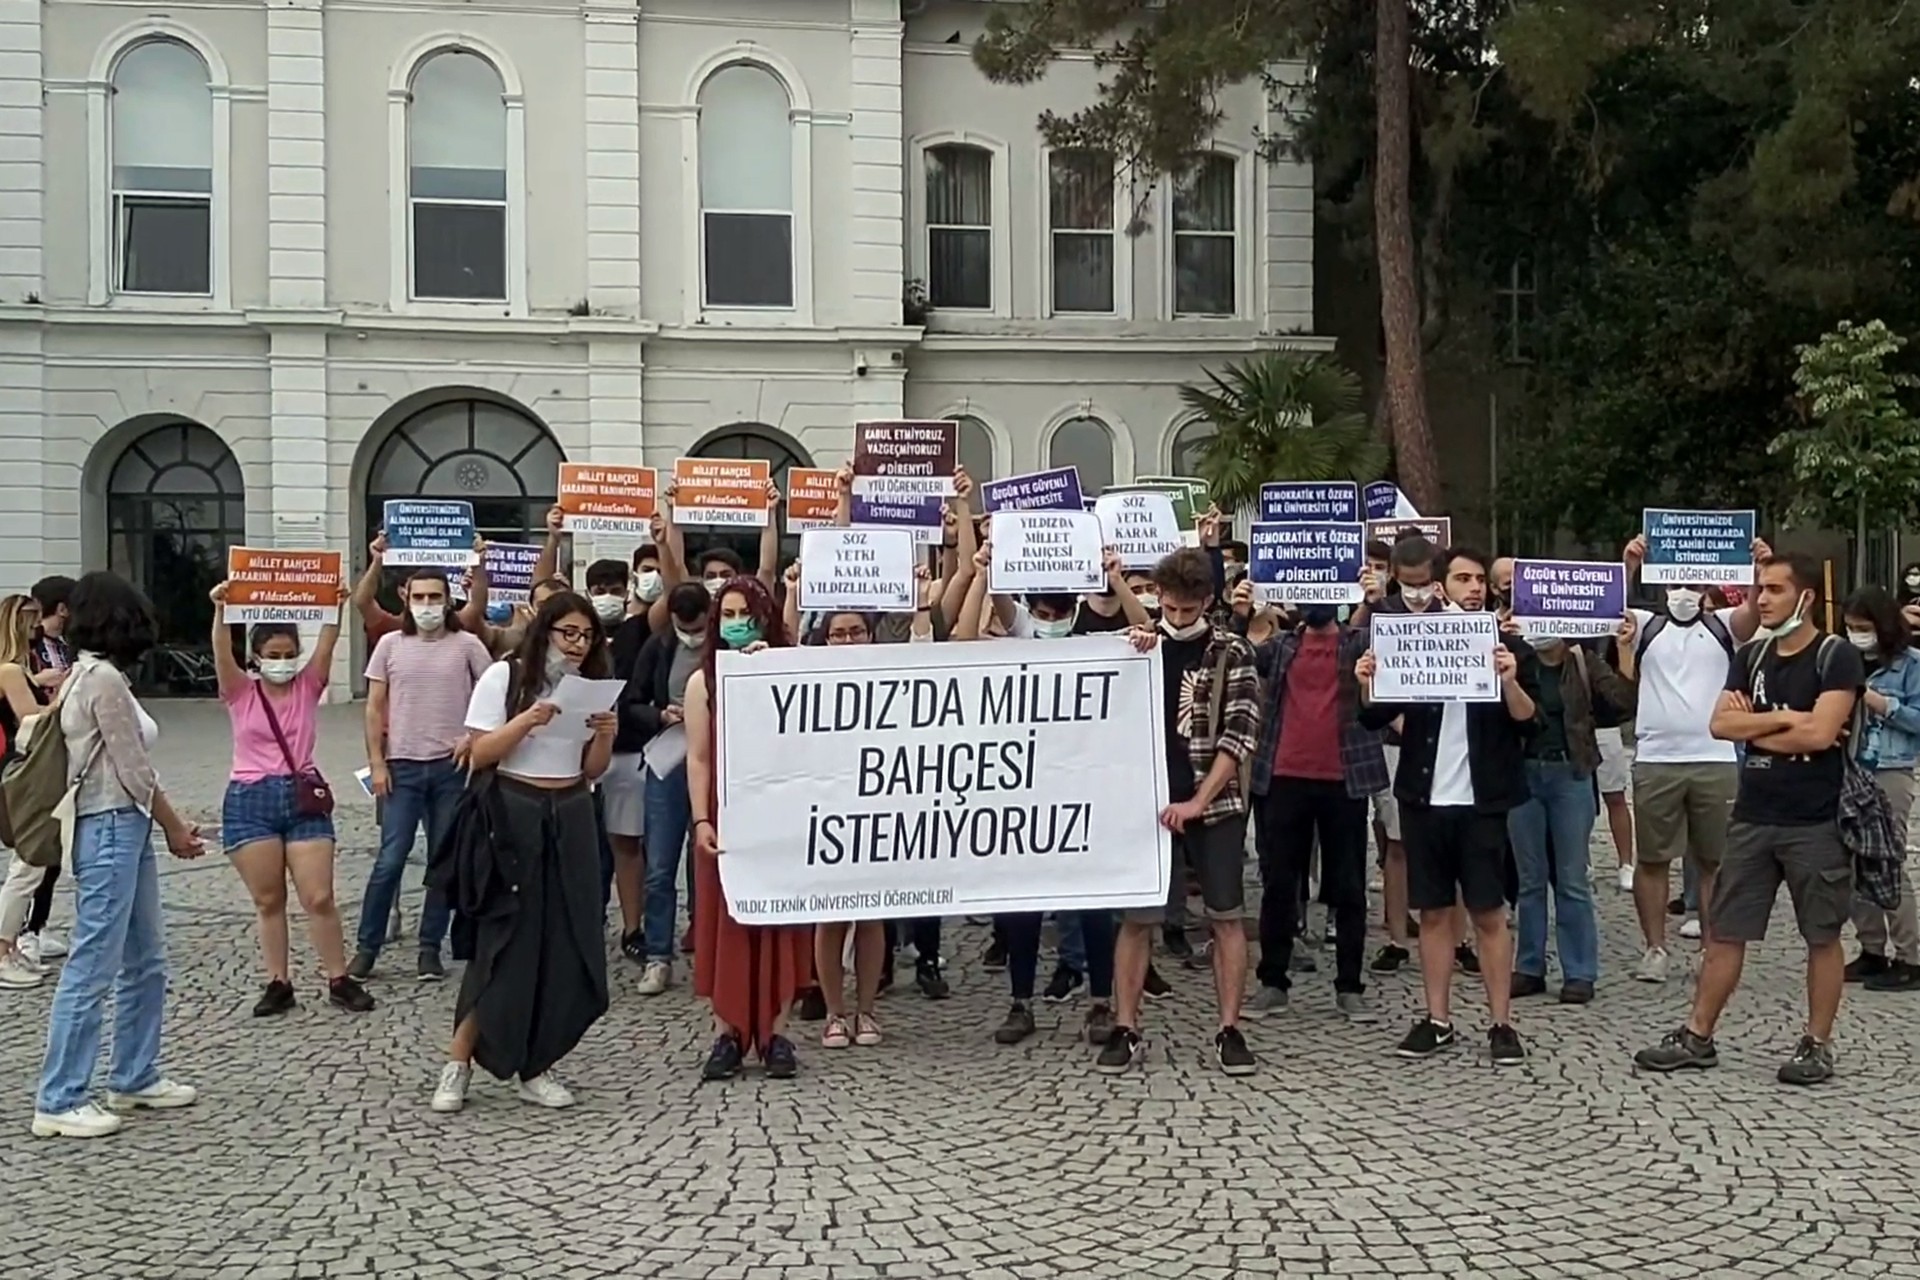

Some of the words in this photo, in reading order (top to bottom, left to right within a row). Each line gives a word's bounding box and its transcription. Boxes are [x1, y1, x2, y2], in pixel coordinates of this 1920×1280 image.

[865, 429, 892, 440] KABUL
[894, 427, 946, 441] ETMİYORUZ,
[867, 442, 941, 457] VAZGEÇMİYORUZ!
[692, 465, 719, 476] MİLLET
[720, 466, 751, 478] BAHÇESİ
[877, 461, 934, 475] #DİRENYTÜ
[577, 470, 605, 482] MİLLET
[607, 472, 639, 485] BAHÇESİ
[868, 480, 885, 492] YTÜ
[887, 479, 943, 493] ÖĞRENCİLERİ
[992, 484, 1019, 501] ÖZGÜR
[1019, 484, 1032, 495] VE
[1032, 474, 1068, 493] GÜVENLİ
[1015, 492, 1064, 510] ÜNİVERSİTE
[1263, 488, 1314, 501] DEMOKRATİK
[1316, 489, 1326, 499] VE
[1328, 488, 1354, 499] ÖZERK
[870, 506, 916, 519] İSTİYORUZ!
[1268, 501, 1283, 513] BİR
[1284, 501, 1330, 514] ÜNİVERSİTE
[1331, 501, 1349, 516] İÇİN
[688, 511, 703, 521] YTÜ
[705, 510, 756, 522] ÖĞRENCİLERİ
[1662, 513, 1733, 526] ÜNİVERSİTEMİZDE
[398, 526, 412, 536] SÖZ
[573, 519, 589, 530] YTÜ
[591, 518, 644, 532] ÖĞRENCİLERİ
[1025, 531, 1071, 544] MİLLET
[1115, 527, 1158, 539] KARAR
[1252, 529, 1313, 544] DEMOKRATİK
[1315, 531, 1327, 544] VE
[1329, 529, 1360, 544] ÖZERK
[1651, 528, 1690, 537] ALINACAK
[1692, 528, 1745, 538] KARARLARDA
[1661, 538, 1676, 549] SÖZ
[1678, 538, 1705, 549] SAHİBİ
[1707, 540, 1735, 549] OLMAK
[398, 551, 413, 562] YTÜ
[415, 550, 467, 562] ÖĞRENCİLERİ
[1022, 545, 1073, 559] BAHÇESİ
[1257, 545, 1274, 560] BİR
[1276, 545, 1332, 559] ÜNİVERSİTE
[1334, 545, 1355, 562] İÇİN
[1675, 551, 1719, 562] İSTİYORUZ!
[249, 556, 280, 568] MİLLET
[283, 558, 321, 571] BAHÇESİ
[230, 571, 272, 582] KARARINI
[275, 572, 337, 583] TANIMIYORUZ!
[834, 565, 880, 578] KARAR
[1275, 566, 1339, 581] #DİRENYTÜ
[1523, 567, 1556, 580] ÖZGÜR
[1558, 570, 1570, 581] VE
[1572, 569, 1613, 582] GÜVENLİ
[1659, 569, 1676, 580] YTÜ
[1679, 567, 1738, 581] ÖĞRENCİLERİ
[809, 581, 905, 594] YILDIZLILARIN!
[1265, 588, 1283, 600] YTÜ
[1286, 587, 1349, 601] ÖĞRENCİLERİ
[1532, 582, 1548, 595] BİR
[1551, 582, 1605, 596] ÜNİVERSİTE
[1542, 597, 1594, 611] İSTİYORUZ!
[241, 608, 260, 620] YTÜ
[263, 607, 323, 620] ÖĞRENCİLERİ
[1376, 619, 1492, 636] KAMPÜSLERİMİZ
[1528, 621, 1546, 633] YTÜ
[1549, 620, 1610, 634] ÖĞRENCİLERİ
[1397, 636, 1470, 652] İKTİDARIN
[1383, 655, 1421, 668] ARKA
[1426, 652, 1486, 671] BAHÇESİ
[771, 677, 965, 734] YILDIZ'DA
[979, 664, 1119, 725] MİLLET
[858, 729, 1037, 806] BAHÇESİ
[806, 799, 1092, 866] İSTEMİYORUZ!
[735, 898, 767, 914] YILDIZ
[769, 895, 808, 914] TEKNİK
[810, 891, 881, 912] ÜNİVERSİTESİ
[884, 888, 954, 908] ÖĞRENCİLERİ
